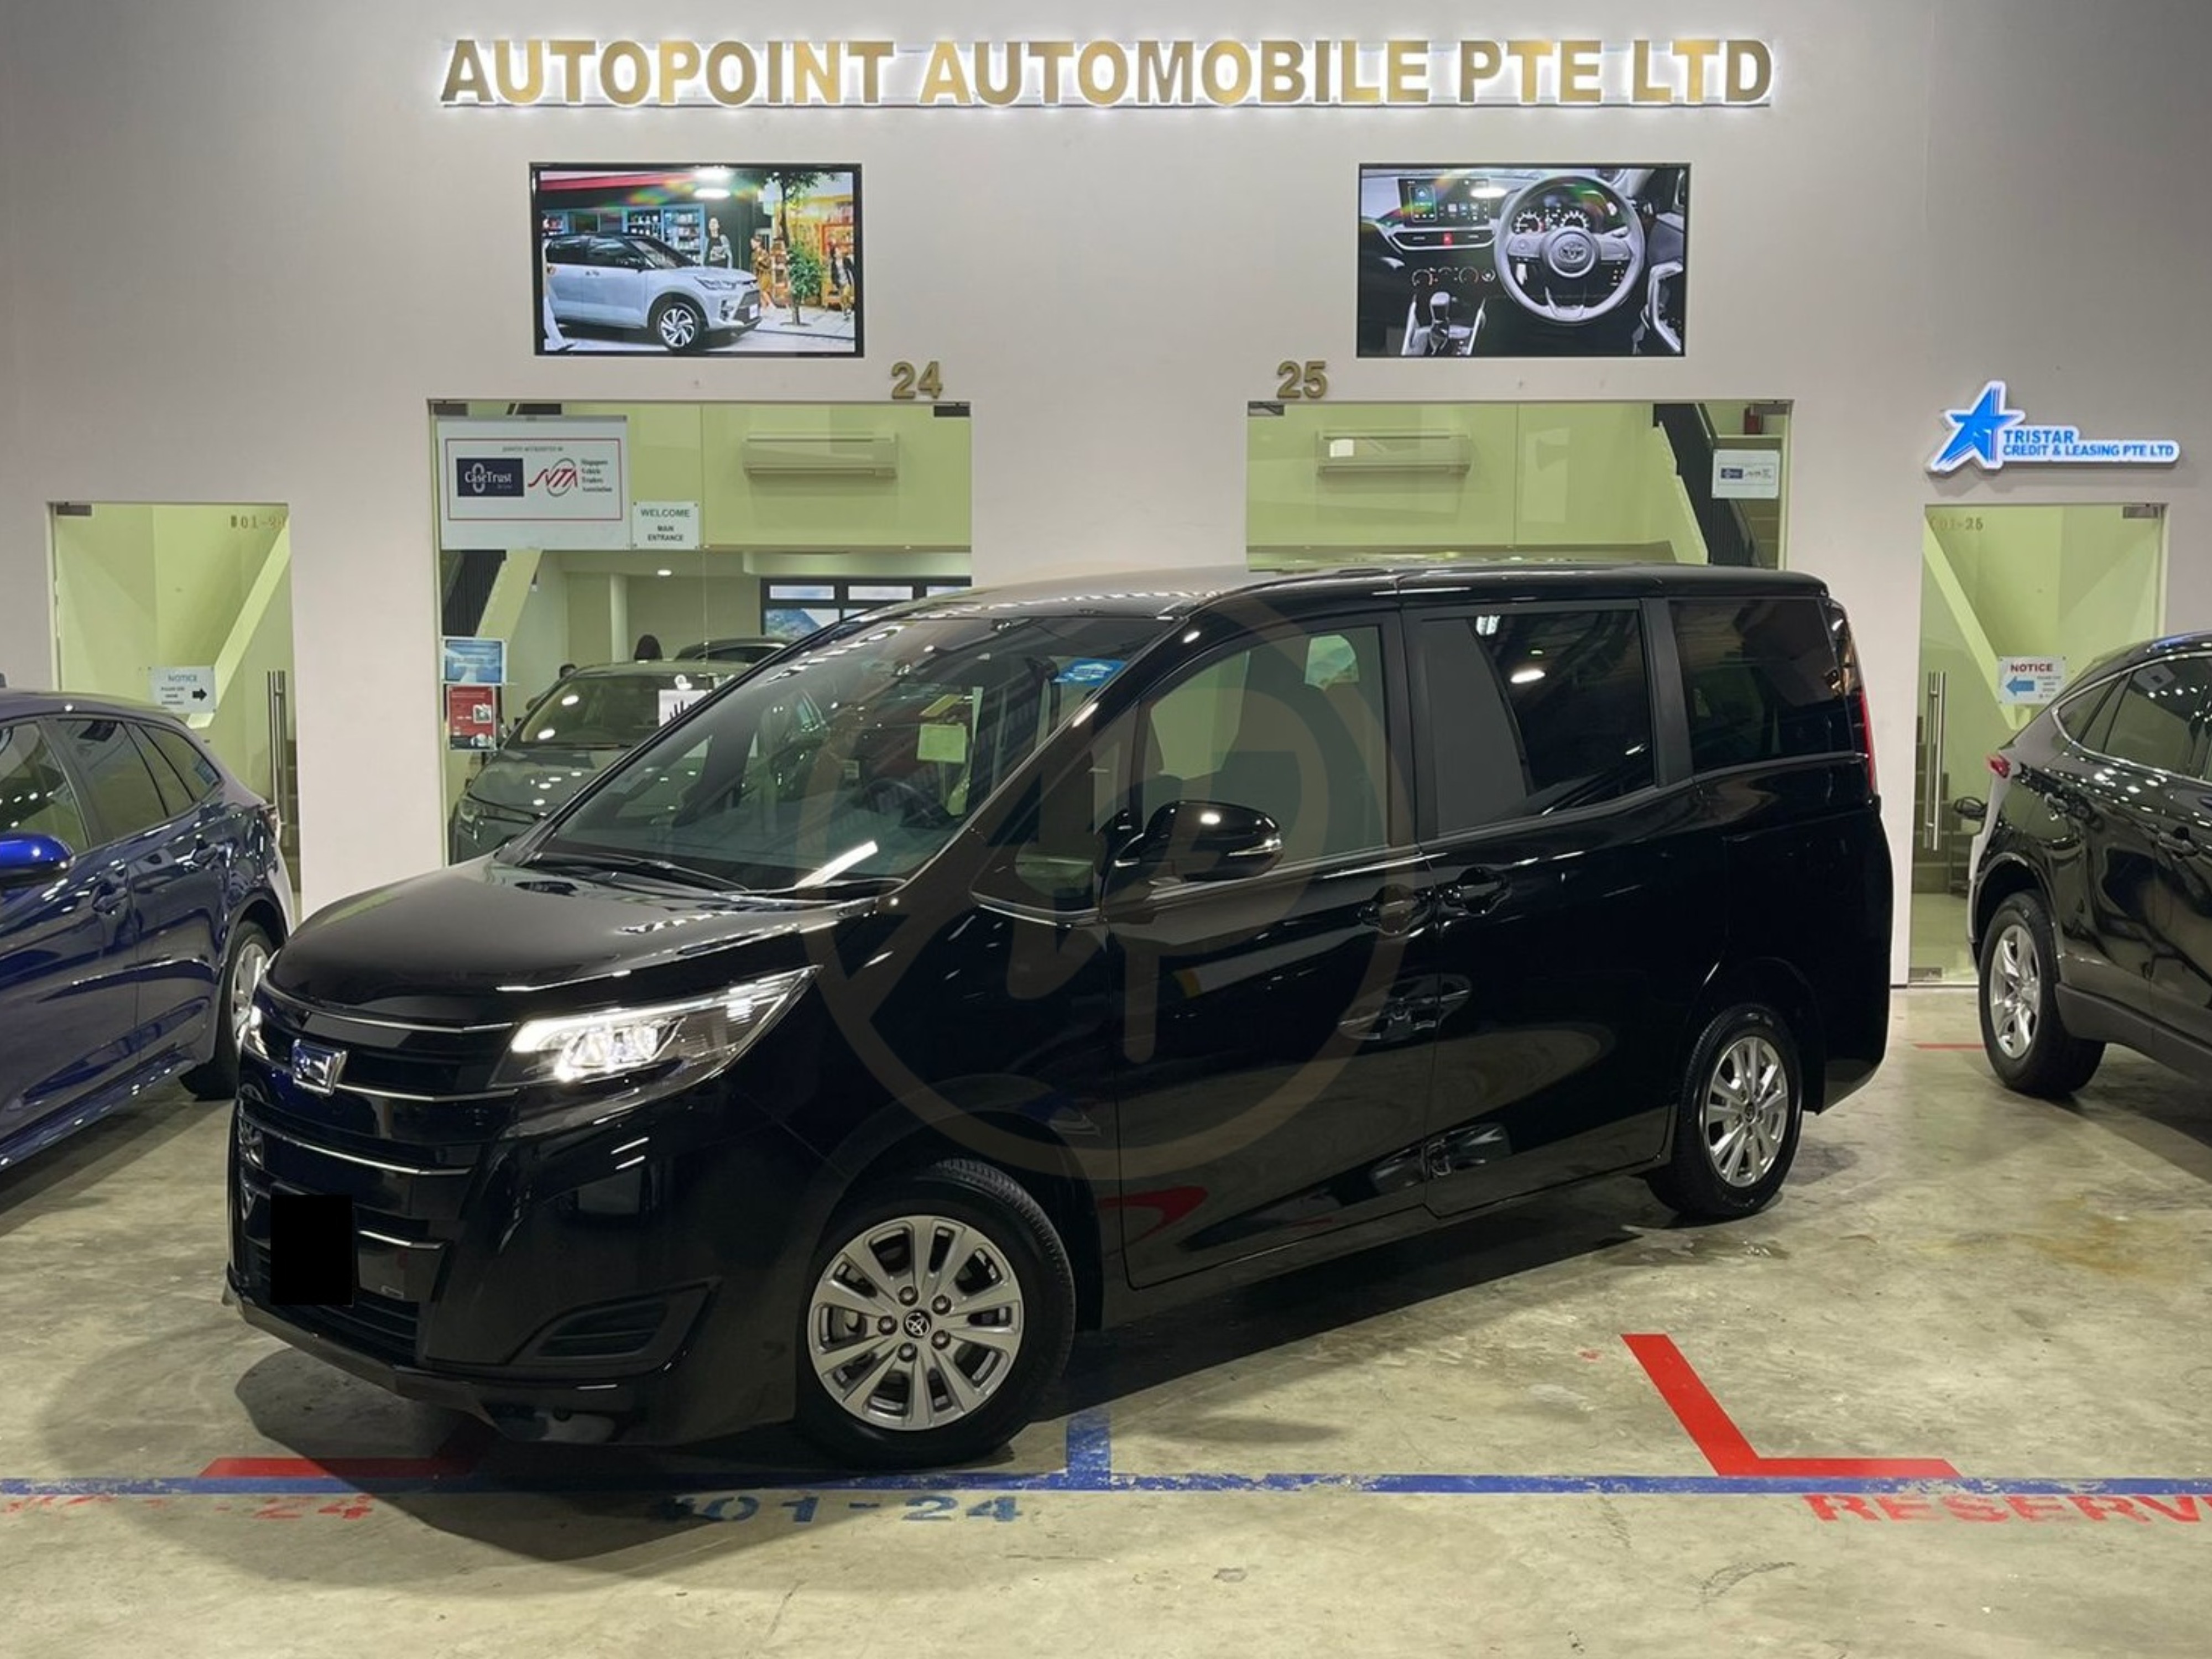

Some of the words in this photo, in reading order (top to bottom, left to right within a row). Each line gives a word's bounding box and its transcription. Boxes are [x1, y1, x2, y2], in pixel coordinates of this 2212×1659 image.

[441, 40, 894, 105] AUTOPOINT
[919, 40, 1430, 105] AUTOMOBILE
[1459, 40, 1601, 103] PTE
[1632, 39, 1771, 103] LTD
[890, 361, 943, 400] 24
[1276, 361, 1327, 399] 25
[2003, 429, 2074, 443] TRISTAR
[2003, 445, 2046, 456] CREDIT
[2052, 445, 2061, 456] &
[2065, 445, 2120, 456] LEASING
[2123, 445, 2146, 456] PTE
[2150, 446, 2174, 456] LTD
[465, 471, 512, 483] CaseTrust
[640, 509, 691, 518] WELCOME
[2010, 664, 2054, 672] NOTICE
[168, 674, 197, 682] NOTICE
[1802, 1494, 2212, 1522] RESERV
